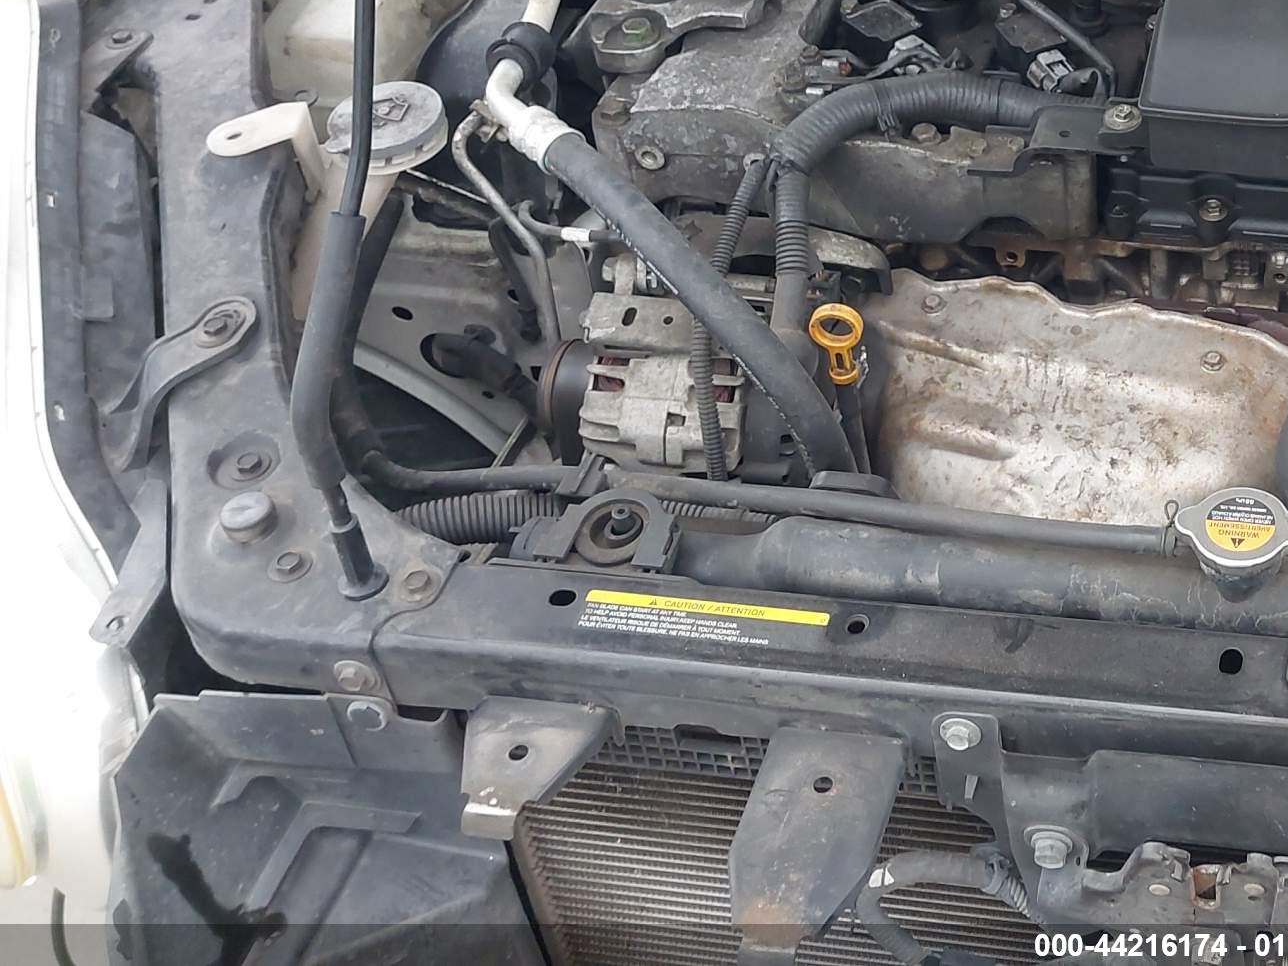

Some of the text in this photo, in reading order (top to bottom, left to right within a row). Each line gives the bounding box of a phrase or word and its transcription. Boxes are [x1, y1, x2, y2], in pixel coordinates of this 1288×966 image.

[1209, 522, 1271, 532] AVERTISSEMENT
[1218, 529, 1260, 539] WARNING
[664, 600, 706, 611] CAUTION
[713, 605, 766, 616] ATTENTION
